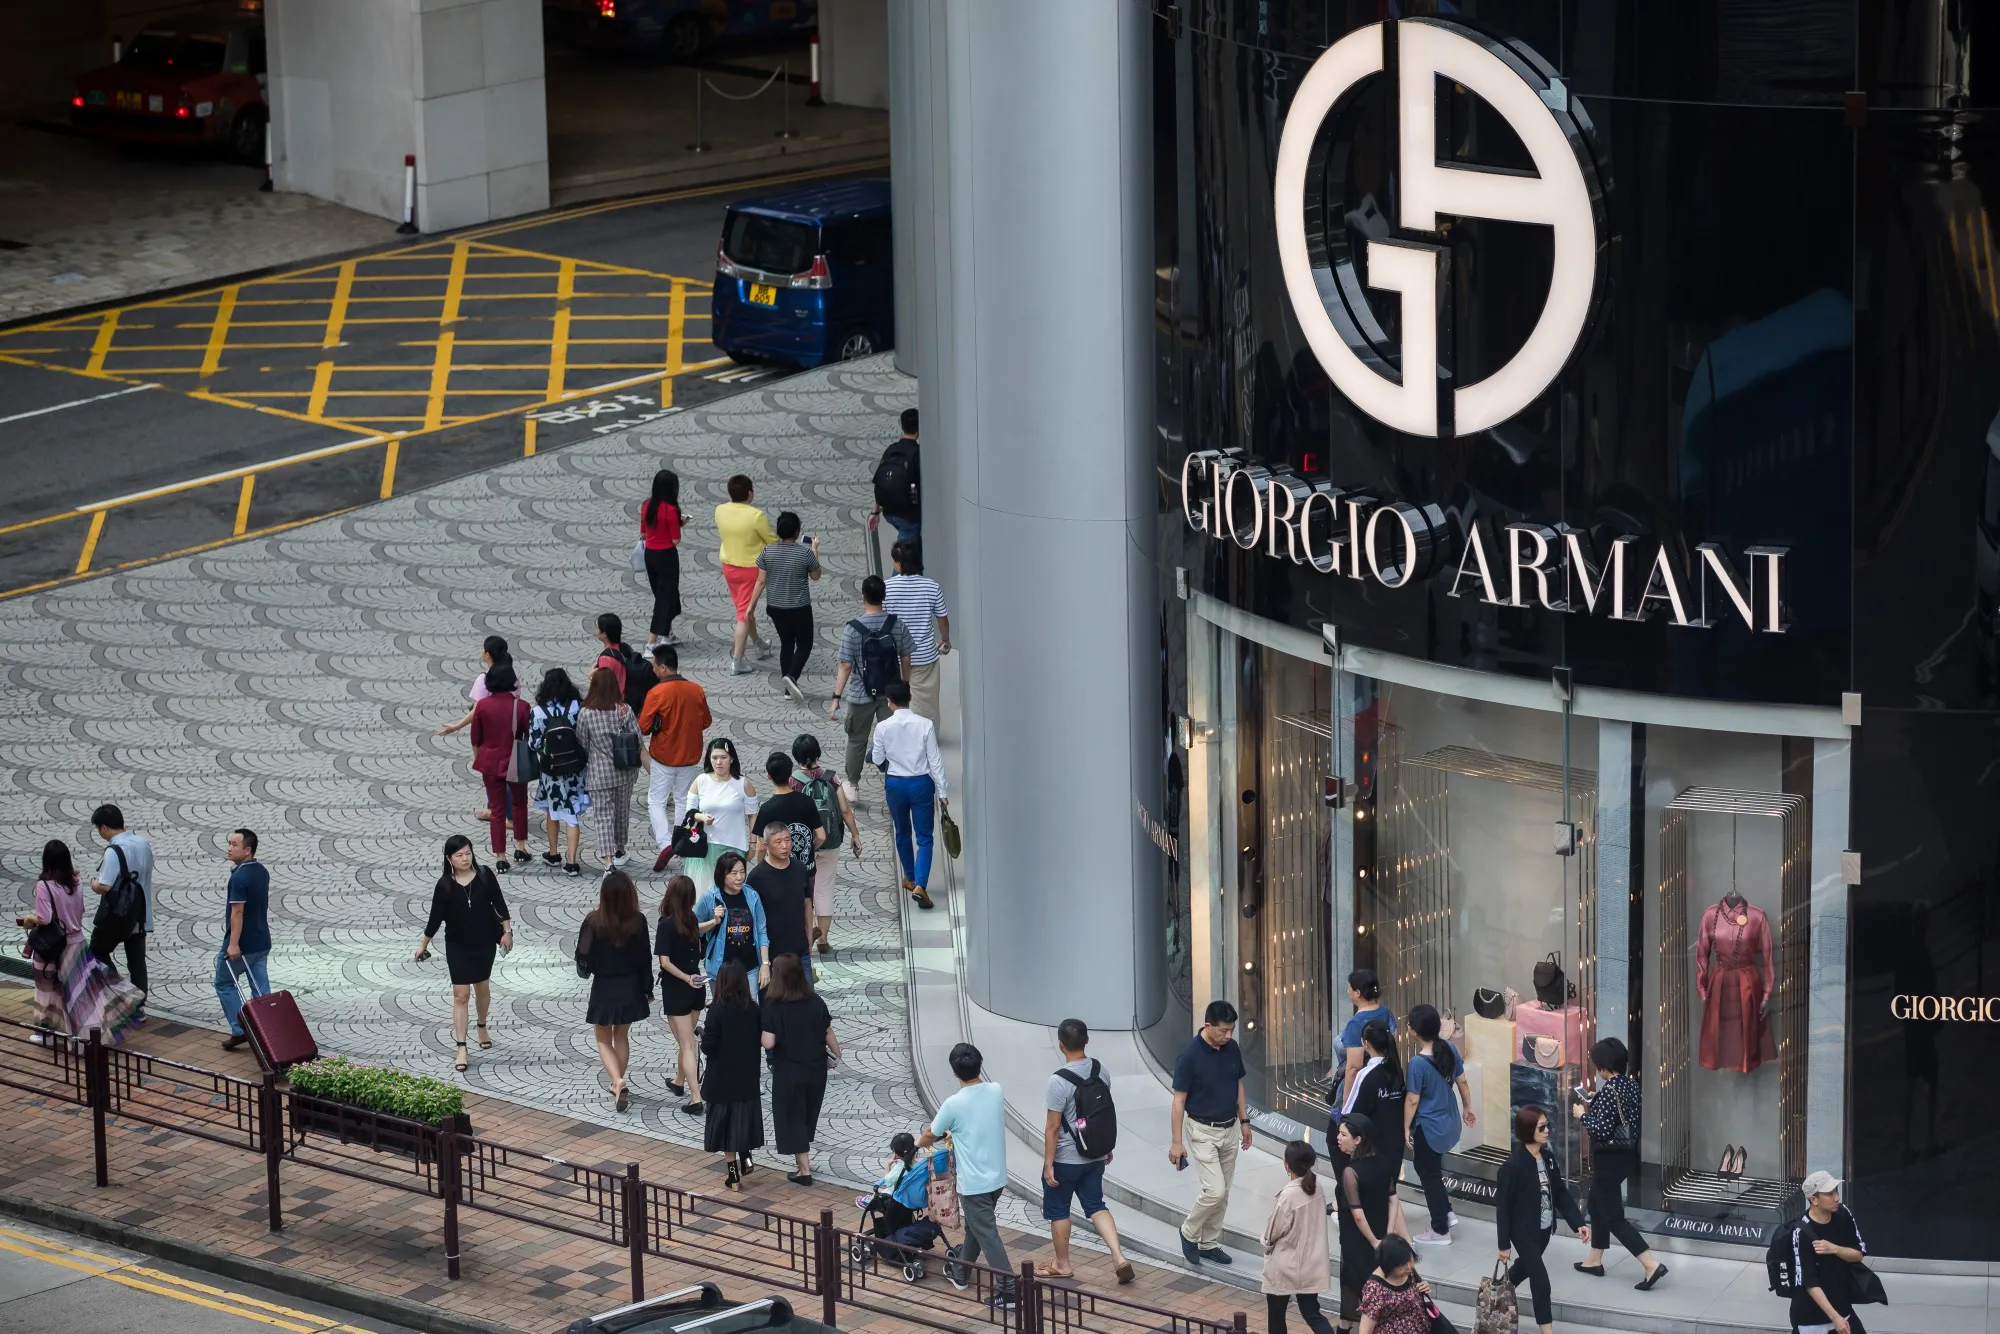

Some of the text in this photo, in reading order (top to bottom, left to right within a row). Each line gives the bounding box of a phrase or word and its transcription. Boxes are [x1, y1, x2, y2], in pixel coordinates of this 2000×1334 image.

[1181, 448, 1789, 633] GIORGIO ARMANI
[1150, 819, 1178, 861] ARMANI
[727, 925, 750, 933] KENZO
[1891, 994, 2000, 1022] GIORGIO
[1245, 1103, 1268, 1122] IORGIO
[1458, 1181, 1498, 1198] ARMANI
[1665, 1217, 1762, 1239] GIORGIO ARMANI
